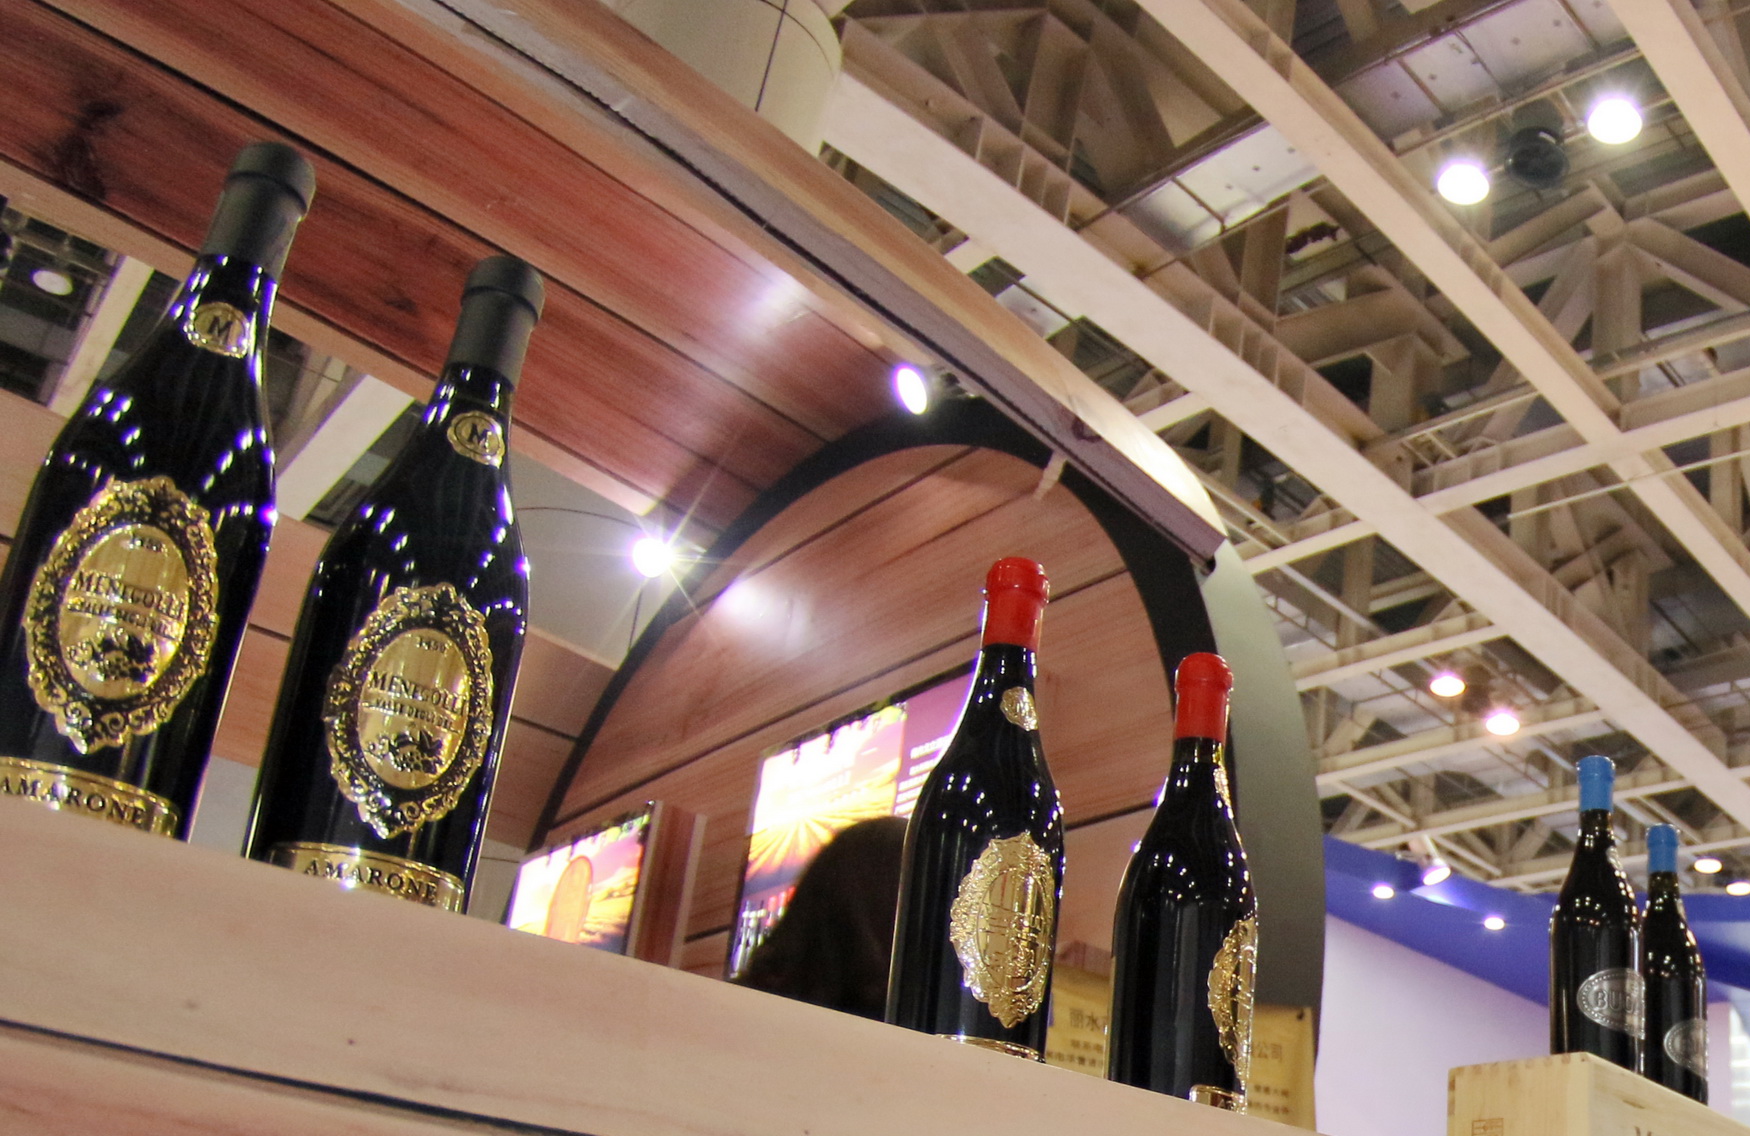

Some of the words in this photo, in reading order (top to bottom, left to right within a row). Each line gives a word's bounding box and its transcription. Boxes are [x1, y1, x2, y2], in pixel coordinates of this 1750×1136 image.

[207, 314, 232, 346] M
[466, 422, 490, 447] M
[367, 669, 468, 716] MENEGOLLI
[304, 858, 438, 903] AMARONE
